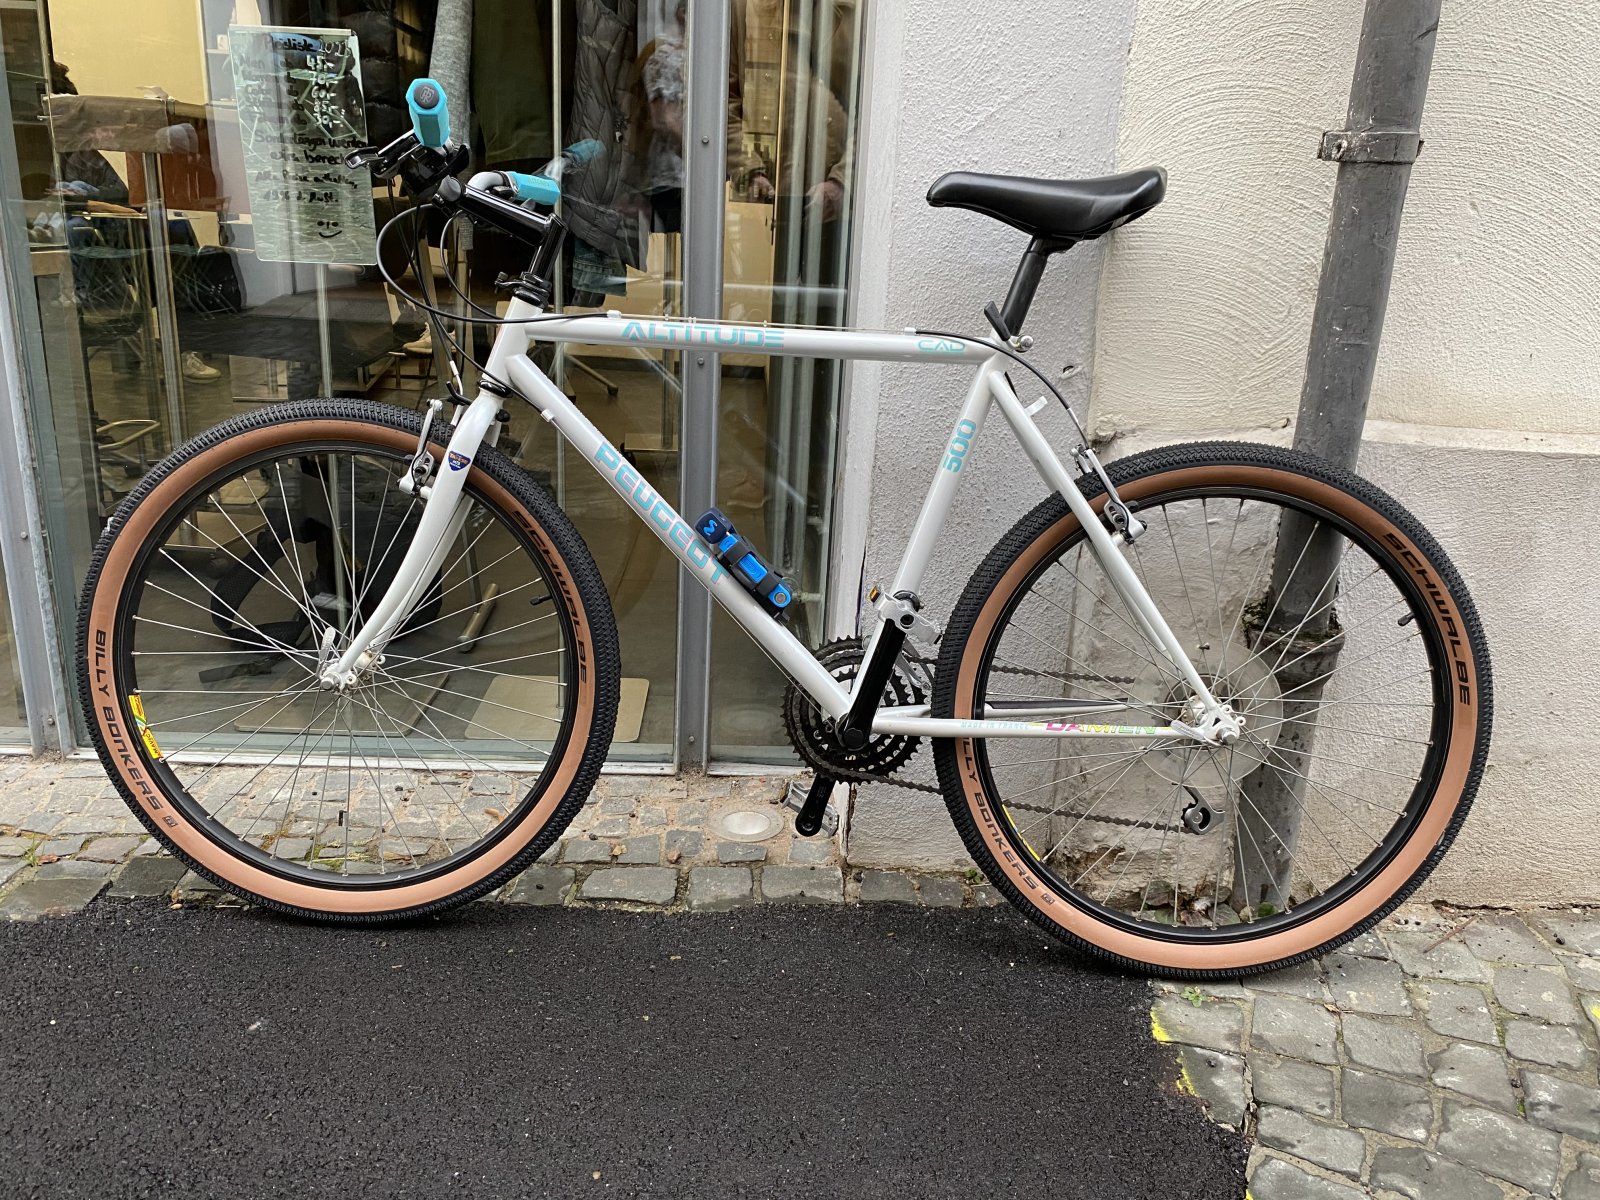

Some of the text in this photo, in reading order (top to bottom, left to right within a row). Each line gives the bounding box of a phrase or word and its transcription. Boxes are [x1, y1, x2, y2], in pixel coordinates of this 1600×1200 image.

[621, 321, 966, 352] ALTITUDE CAD
[594, 441, 730, 584] PEUGEOT
[943, 418, 977, 473] 500
[511, 509, 588, 684] SCHWALBE
[1383, 532, 1470, 706] SCHWALBE
[95, 628, 165, 811] BILLY BONKERS
[974, 791, 1038, 890] BONKERS
